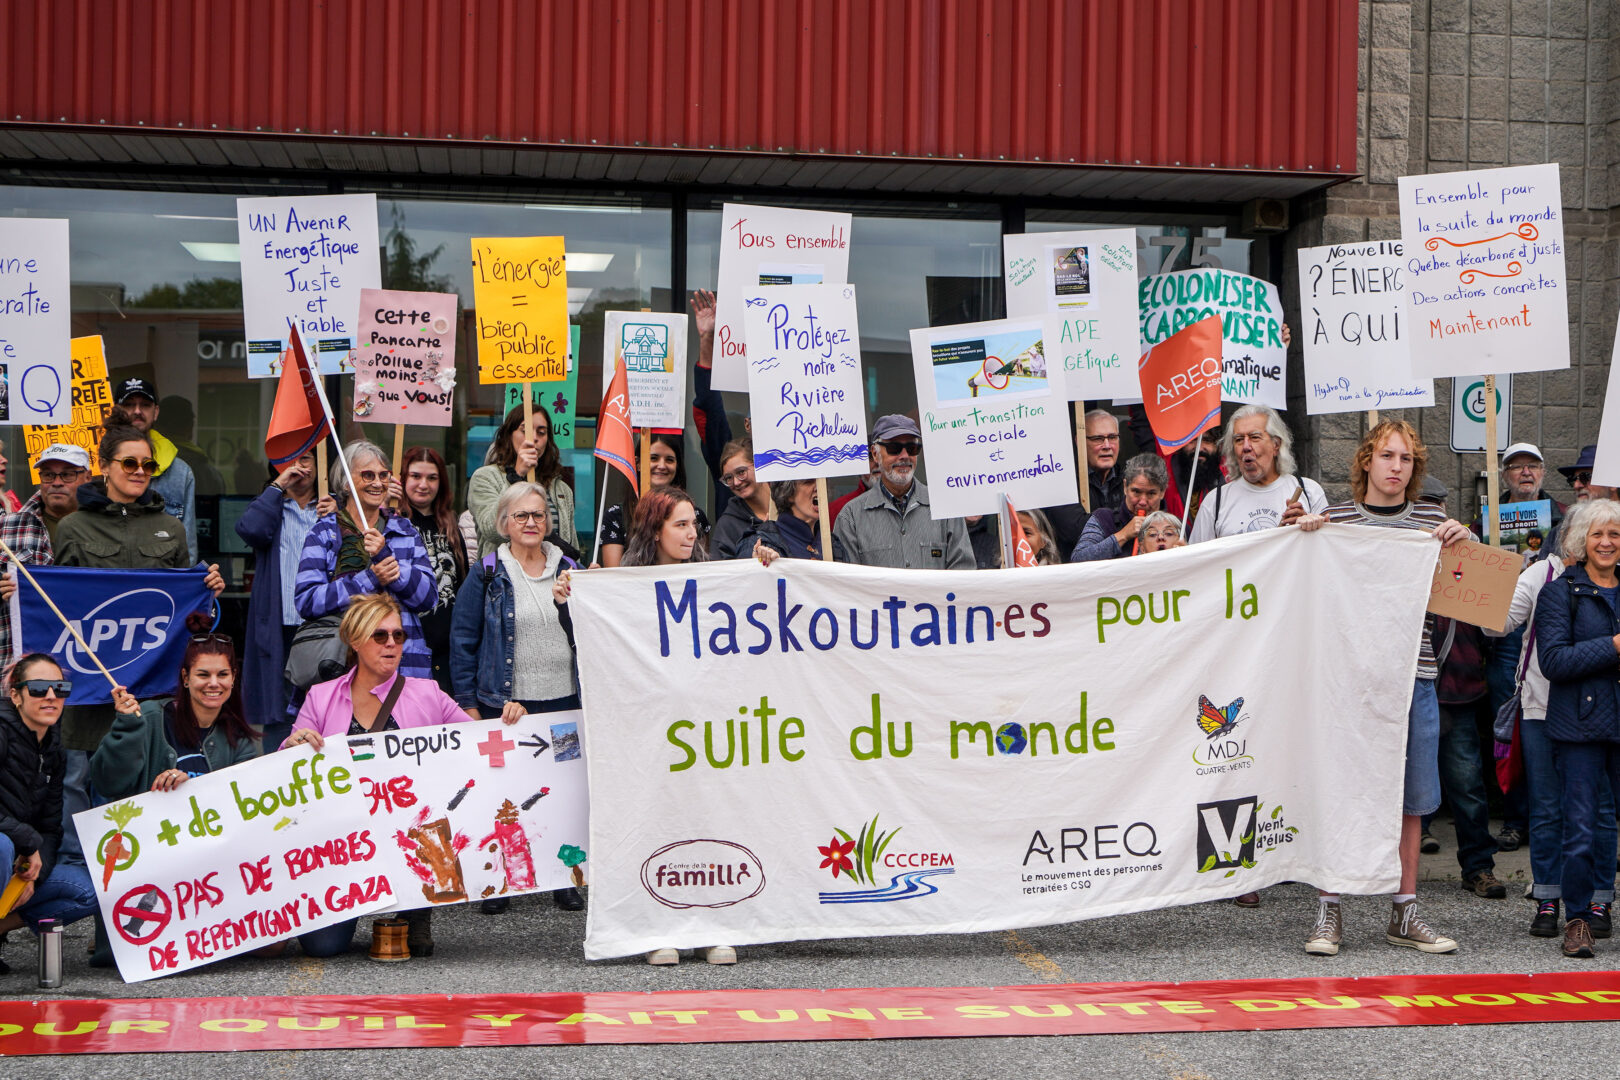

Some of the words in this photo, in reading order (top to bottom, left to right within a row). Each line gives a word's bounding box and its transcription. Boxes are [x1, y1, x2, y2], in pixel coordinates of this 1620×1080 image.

[1416, 182, 1489, 205] Ensemble
[1501, 184, 1536, 205] pour
[249, 213, 276, 233] UN
[730, 218, 775, 249] Tous
[786, 225, 847, 250] ensemble
[1418, 217, 1430, 233] la
[1436, 210, 1478, 232] suite
[1486, 211, 1504, 226] du
[1509, 205, 1557, 224] monde
[1326, 241, 1404, 263] Nouvelle
[1408, 257, 1451, 275] Québec
[1456, 248, 1516, 268] décarboné
[1518, 243, 1527, 258] et
[1529, 239, 1562, 264] juste
[285, 265, 341, 294] Juste
[1412, 291, 1439, 306] Des
[1443, 282, 1486, 303] actions
[1493, 273, 1558, 296] concrètes
[0, 282, 50, 316] ratie
[307, 295, 328, 313] et
[480, 316, 527, 340] bien
[767, 303, 850, 358] Protégez
[1313, 307, 1330, 345] À
[1429, 304, 1532, 340] Maintenant
[370, 331, 442, 348] Pancarte
[495, 334, 556, 361] public
[718, 325, 748, 358] Pou
[492, 355, 565, 380] essentiel
[803, 357, 836, 377] notre
[1157, 358, 1221, 405] AREQ
[21, 364, 61, 418] Q
[378, 390, 399, 406] que
[781, 382, 845, 408] Rivière
[776, 411, 858, 449] Richelieu
[925, 412, 948, 432] Pour
[951, 418, 968, 430] une
[965, 424, 1027, 445] sociale
[946, 454, 1064, 488] environnementale
[989, 448, 1004, 462] et
[1097, 589, 1190, 643] pour
[1225, 568, 1259, 620] la
[52, 616, 170, 654] APTS
[385, 727, 462, 766] Depuis
[666, 695, 805, 772] suite
[850, 693, 913, 761] du
[950, 691, 1116, 759] monde
[1208, 740, 1247, 761] MDJ
[188, 796, 223, 837] de
[231, 753, 352, 821] bouffe
[1022, 822, 1162, 866] AREQ
[174, 871, 224, 920] PAS
[240, 855, 272, 895] DE
[285, 829, 376, 881] BOMBES
[884, 853, 954, 868] CCCPEM
[1022, 873, 1033, 882] Le
[1035, 870, 1091, 882] mouvement
[1094, 867, 1111, 877] des
[1114, 863, 1163, 877] personnes
[1023, 882, 1068, 895] retraitées
[1071, 880, 1091, 890] CSQ
[149, 940, 179, 971] DE
[185, 899, 301, 960] REPENTIGNY
[325, 875, 393, 912] GAZA
[472, 1013, 526, 1027] Y
[556, 1010, 708, 1025] AIT
[736, 1007, 934, 1023] UNE
[955, 1000, 1216, 1018] SUITE
[1229, 995, 1361, 1012] DU
